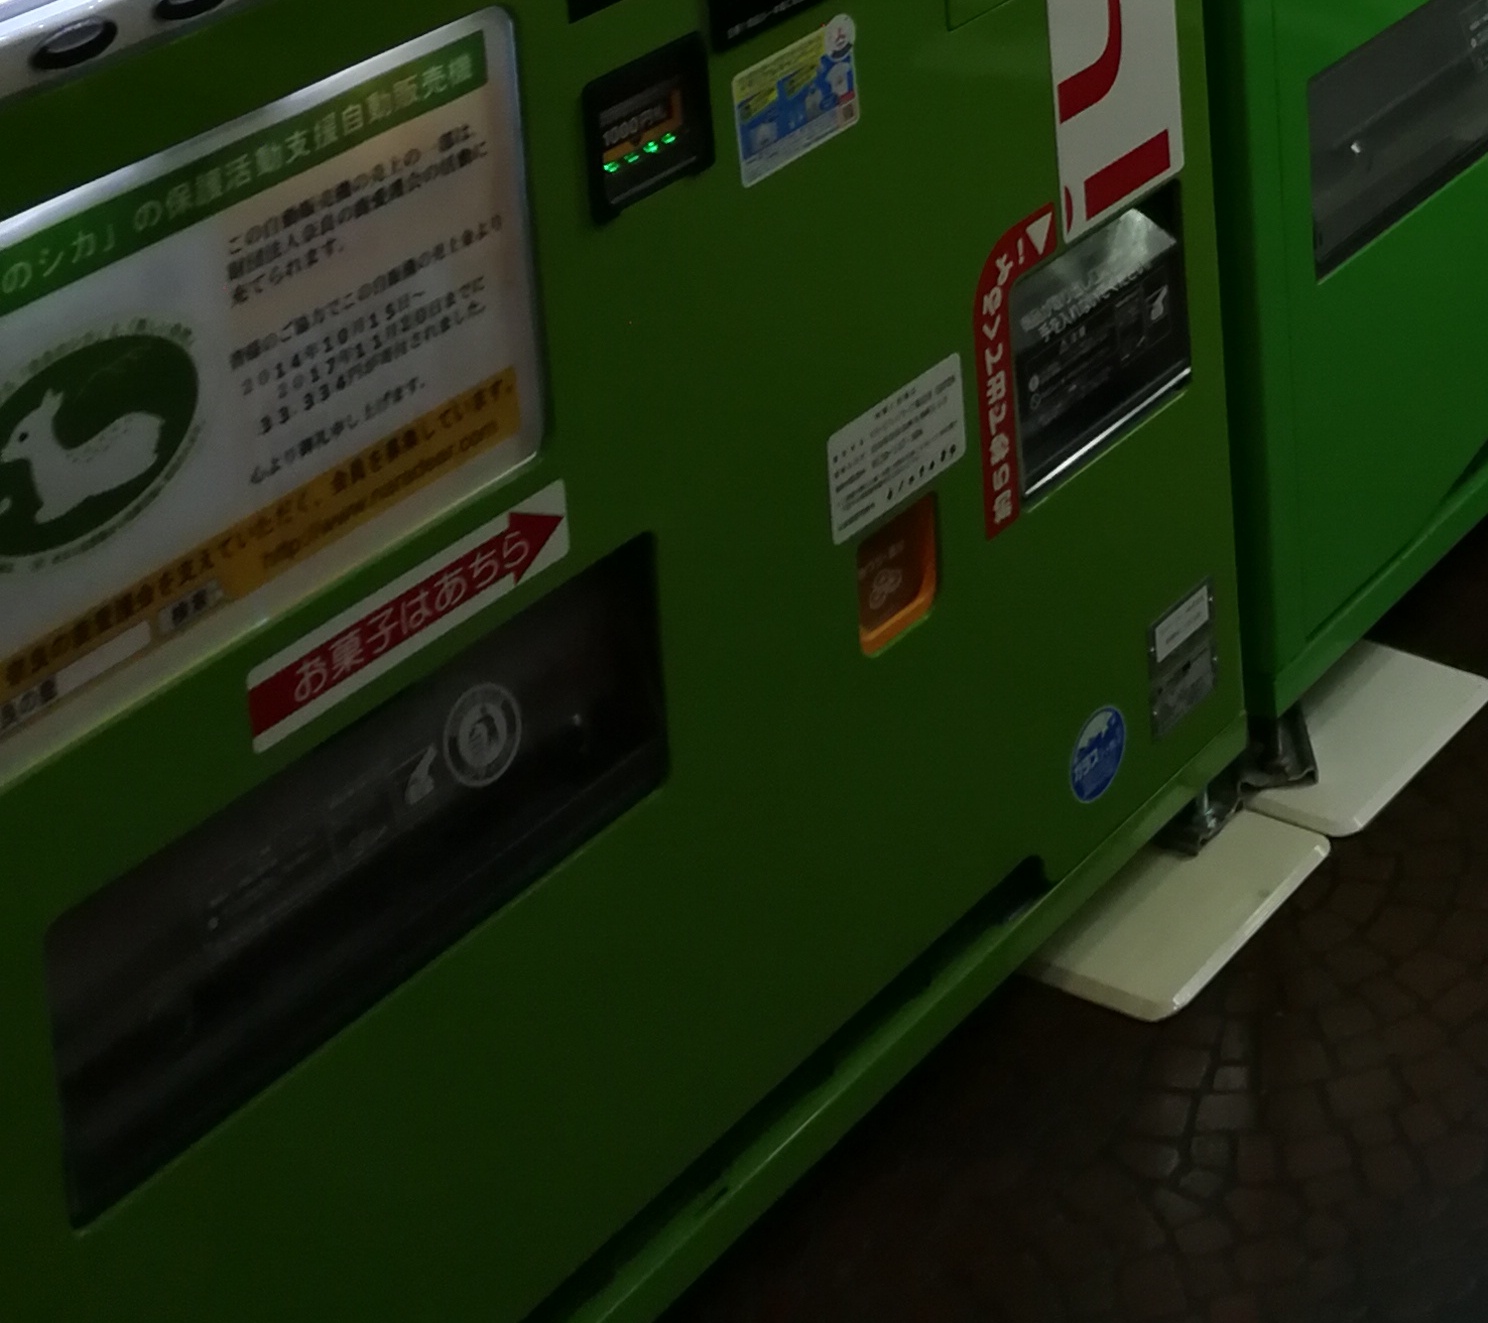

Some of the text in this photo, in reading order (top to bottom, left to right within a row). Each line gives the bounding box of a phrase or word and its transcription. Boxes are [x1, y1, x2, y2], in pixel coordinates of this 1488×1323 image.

[293, 529, 533, 705] お菓子はあちら
